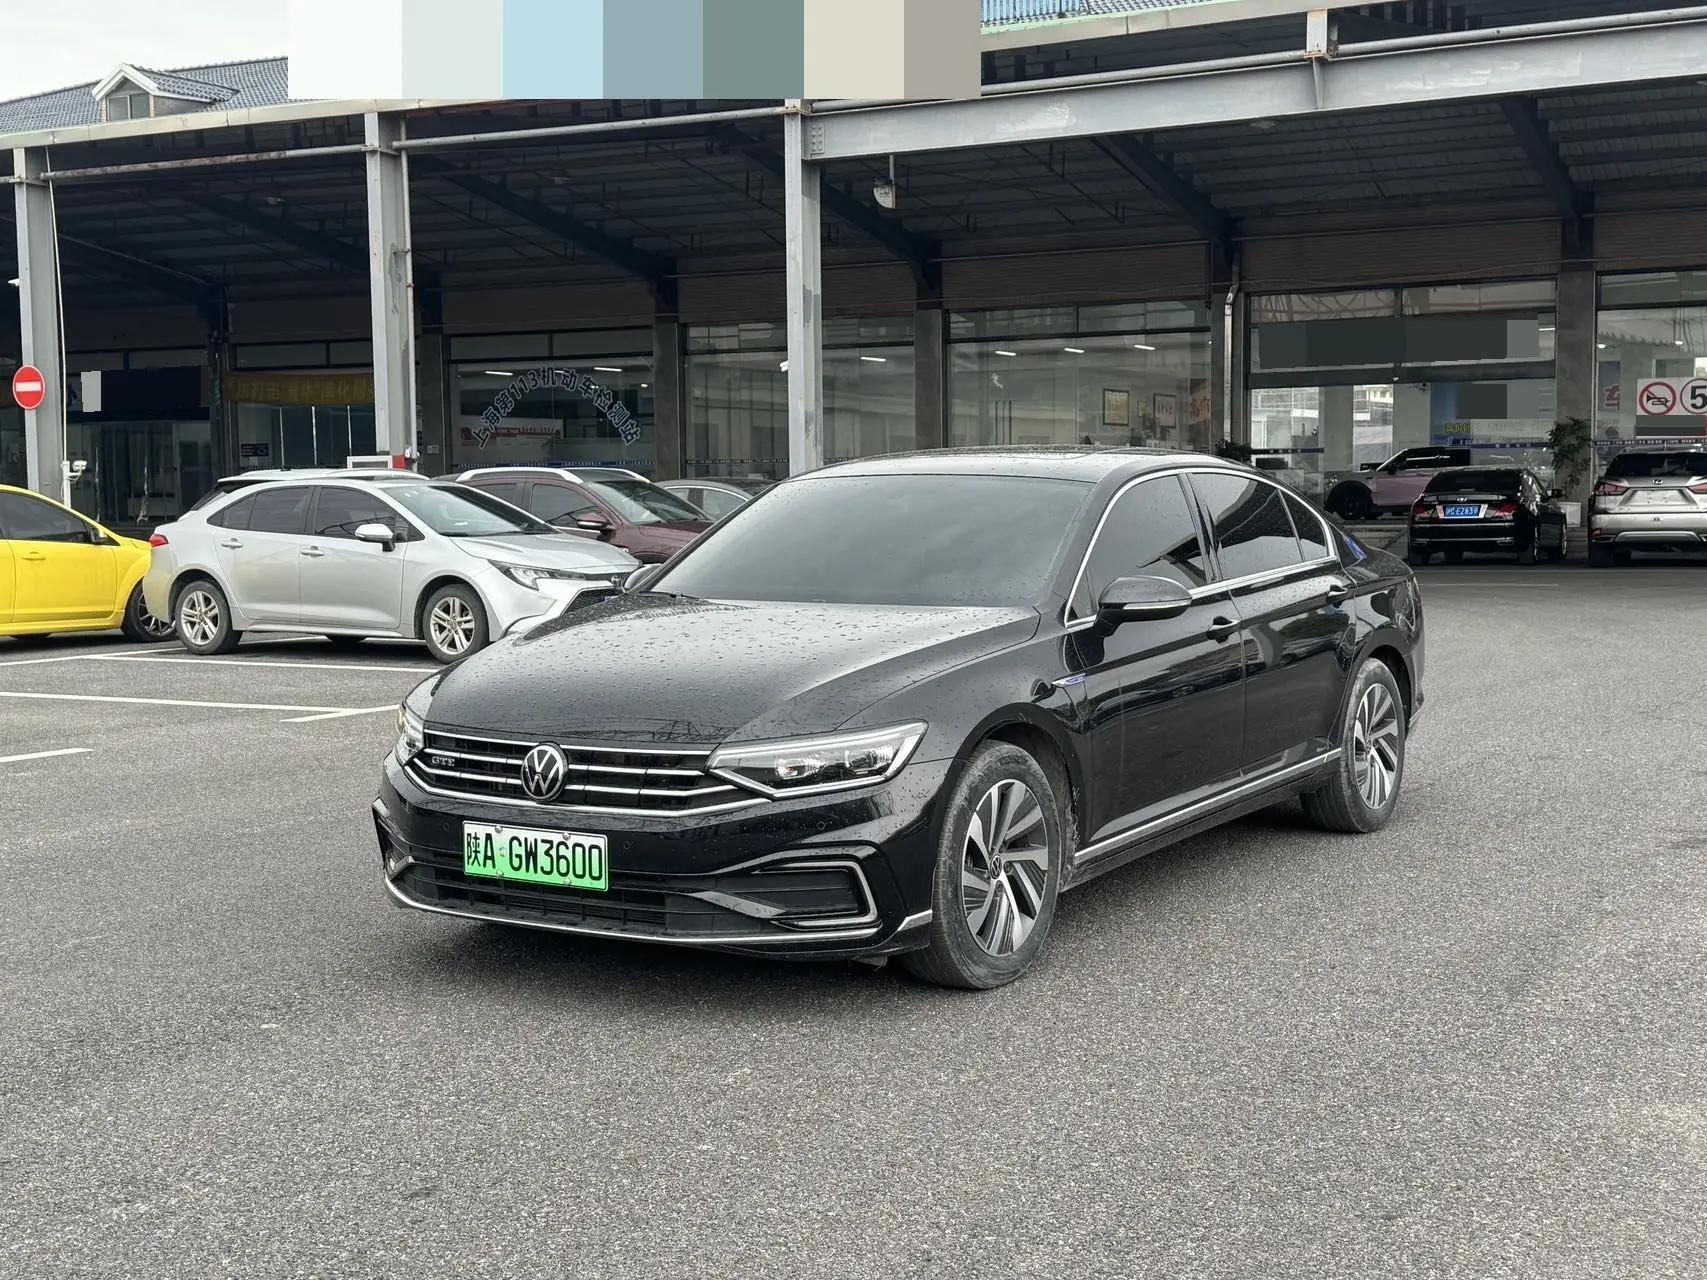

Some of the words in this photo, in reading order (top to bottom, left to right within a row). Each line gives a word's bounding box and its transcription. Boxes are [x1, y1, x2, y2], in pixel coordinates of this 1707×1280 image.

[472, 366, 641, 449] 上海第113机动车检测站
[431, 755, 455, 767] GTE
